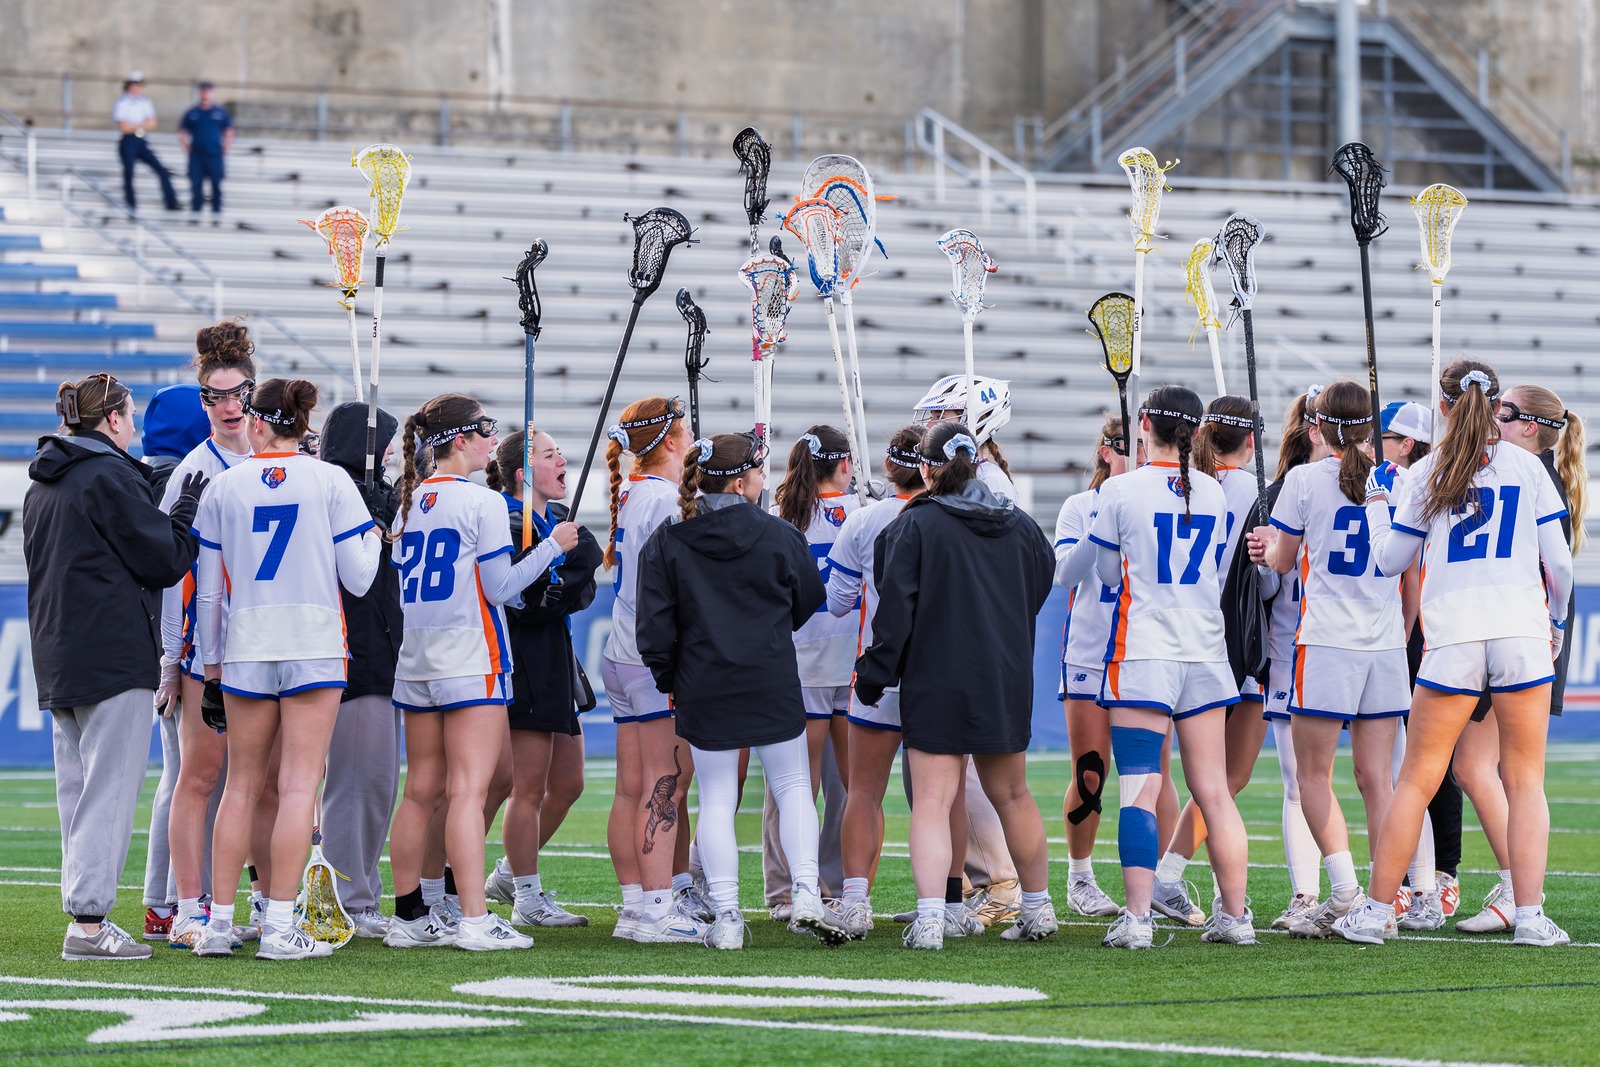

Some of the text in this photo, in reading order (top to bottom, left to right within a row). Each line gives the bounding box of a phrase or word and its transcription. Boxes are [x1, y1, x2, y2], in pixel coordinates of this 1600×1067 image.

[980, 387, 998, 404] 44
[249, 407, 262, 418] GAIT
[263, 415, 281, 424] GAIT
[633, 419, 649, 427] GAIT
[650, 415, 665, 424] GAIT
[1163, 410, 1181, 418] GAIT
[1222, 418, 1237, 426] GAIT
[1351, 417, 1366, 425] GAIT
[1536, 417, 1552, 425] GAIT
[725, 467, 741, 475] GAIT
[1447, 486, 1520, 563] 21
[252, 503, 299, 581] 7
[1153, 512, 1216, 584] 17
[1328, 505, 1397, 577] 3
[401, 527, 461, 604] 28
[100, 936, 123, 954] N
